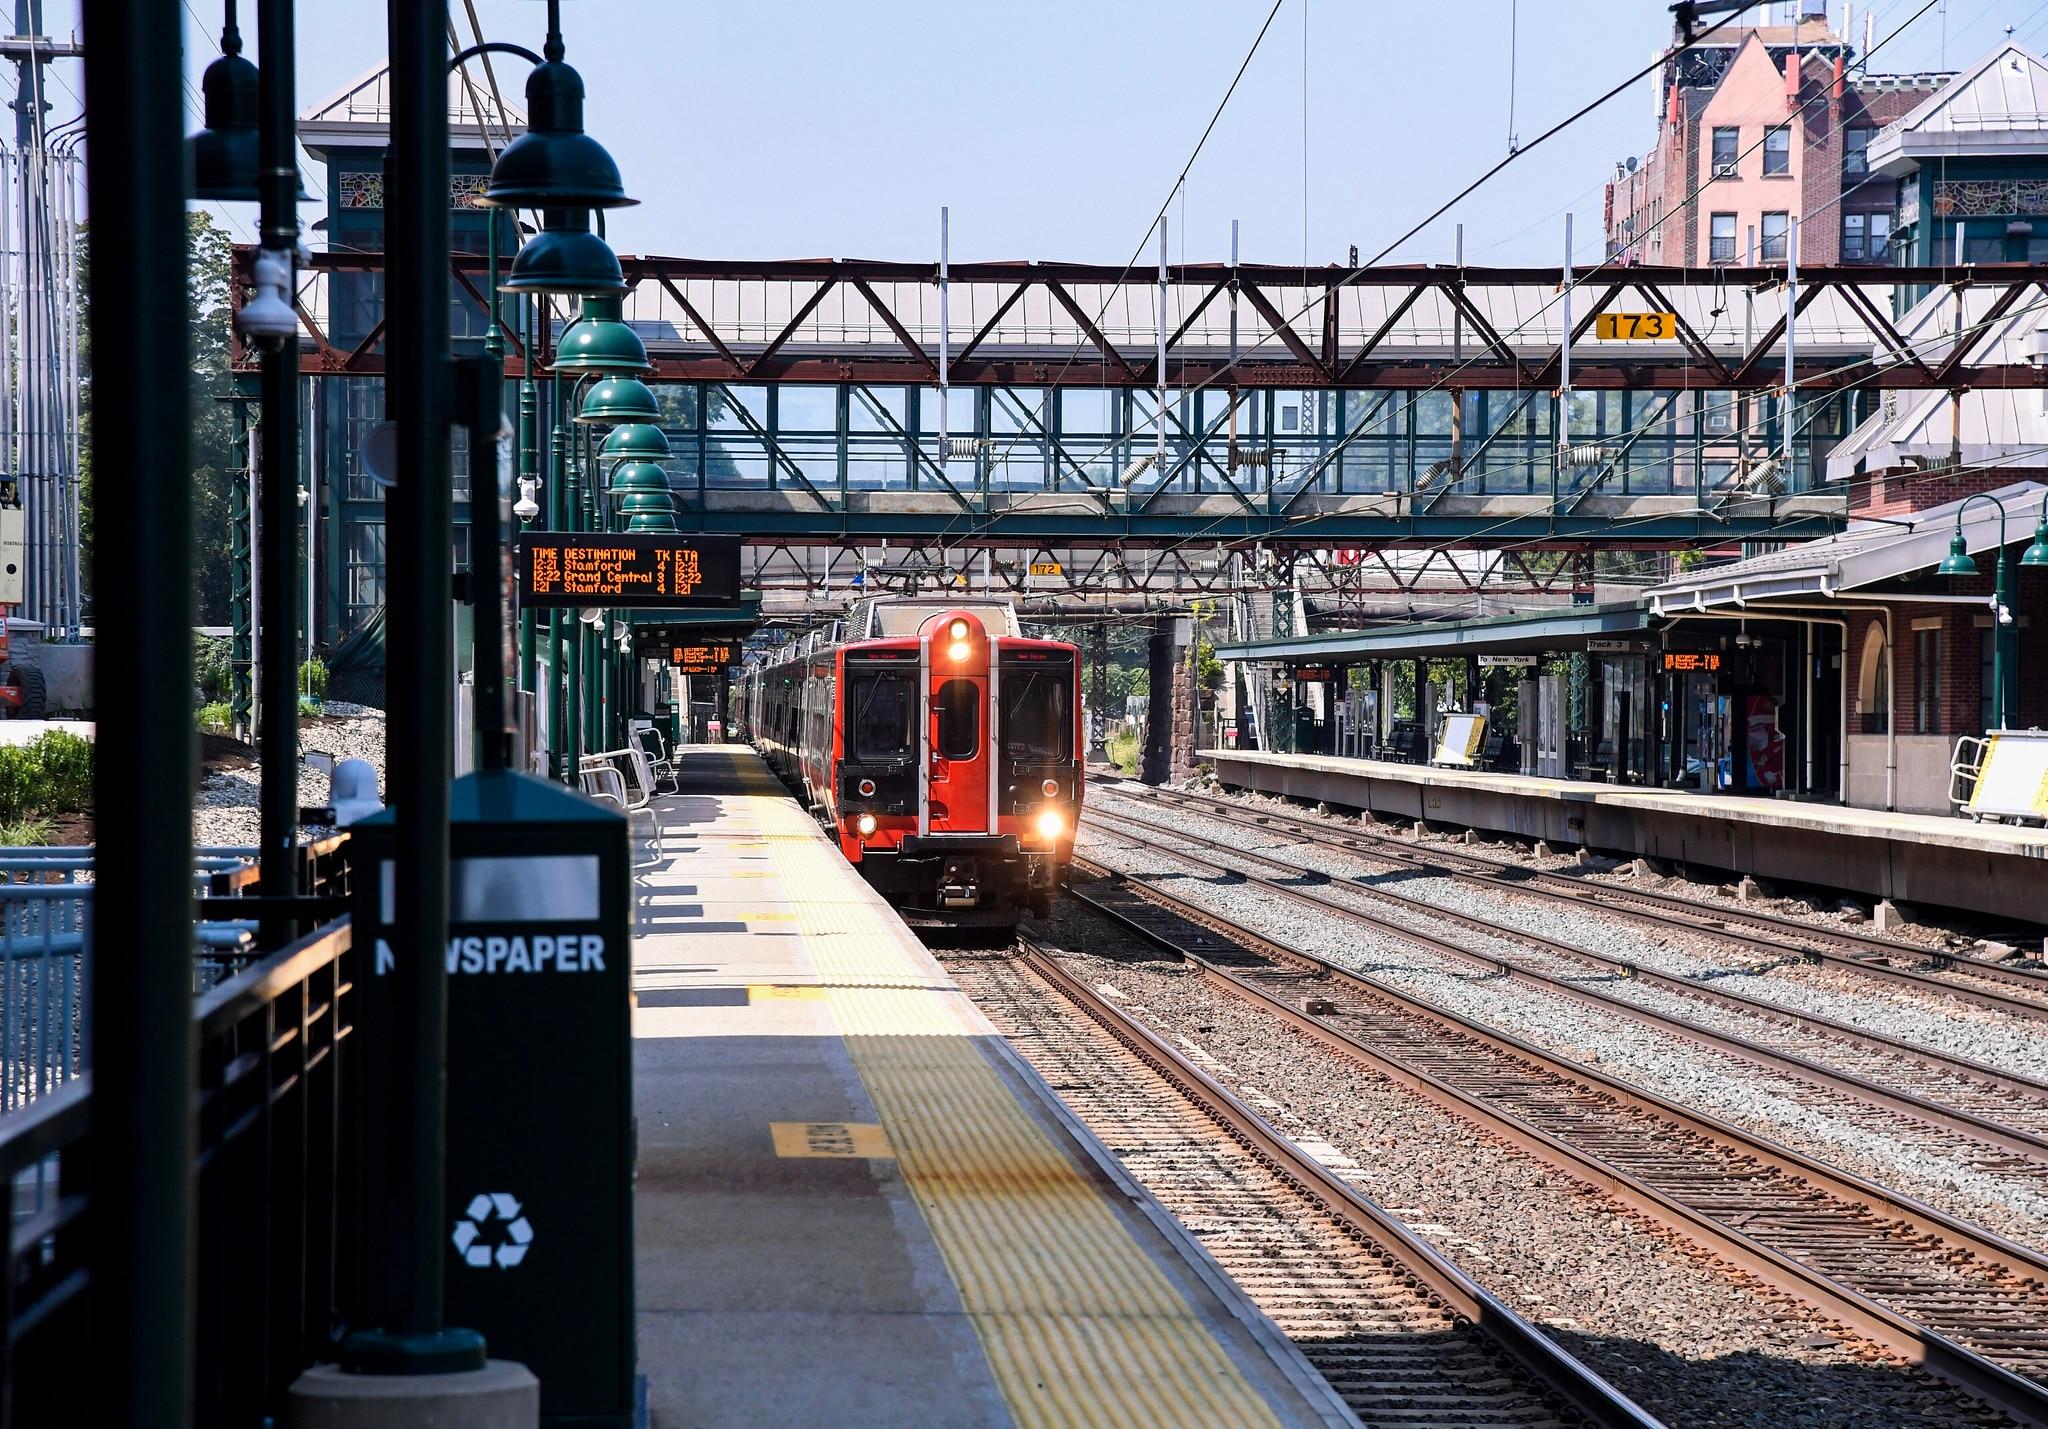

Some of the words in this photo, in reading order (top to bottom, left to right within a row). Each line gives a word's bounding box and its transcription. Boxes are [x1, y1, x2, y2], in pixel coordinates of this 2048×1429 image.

[1610, 315, 1663, 338] 173
[532, 548, 558, 559] TIME
[564, 548, 636, 561] DESTINATION
[655, 549, 670, 561] TK
[675, 550, 698, 562] ETA
[533, 559, 557, 570] 12:21
[564, 559, 622, 571] Stamford
[657, 561, 666, 572] 4
[675, 561, 698, 573] 12:21
[1035, 564, 1055, 574] 172
[533, 570, 561, 581] 12:22
[564, 571, 601, 582] Grand
[607, 571, 652, 583] Central
[657, 572, 665, 583] 3
[675, 572, 702, 584] 12:22
[533, 581, 550, 593] 1:21
[564, 581, 622, 594] Stamford
[657, 583, 666, 594] 4
[675, 583, 691, 595] 1:21
[1590, 640, 1612, 648] Track
[375, 935, 606, 976] NSPAPER
